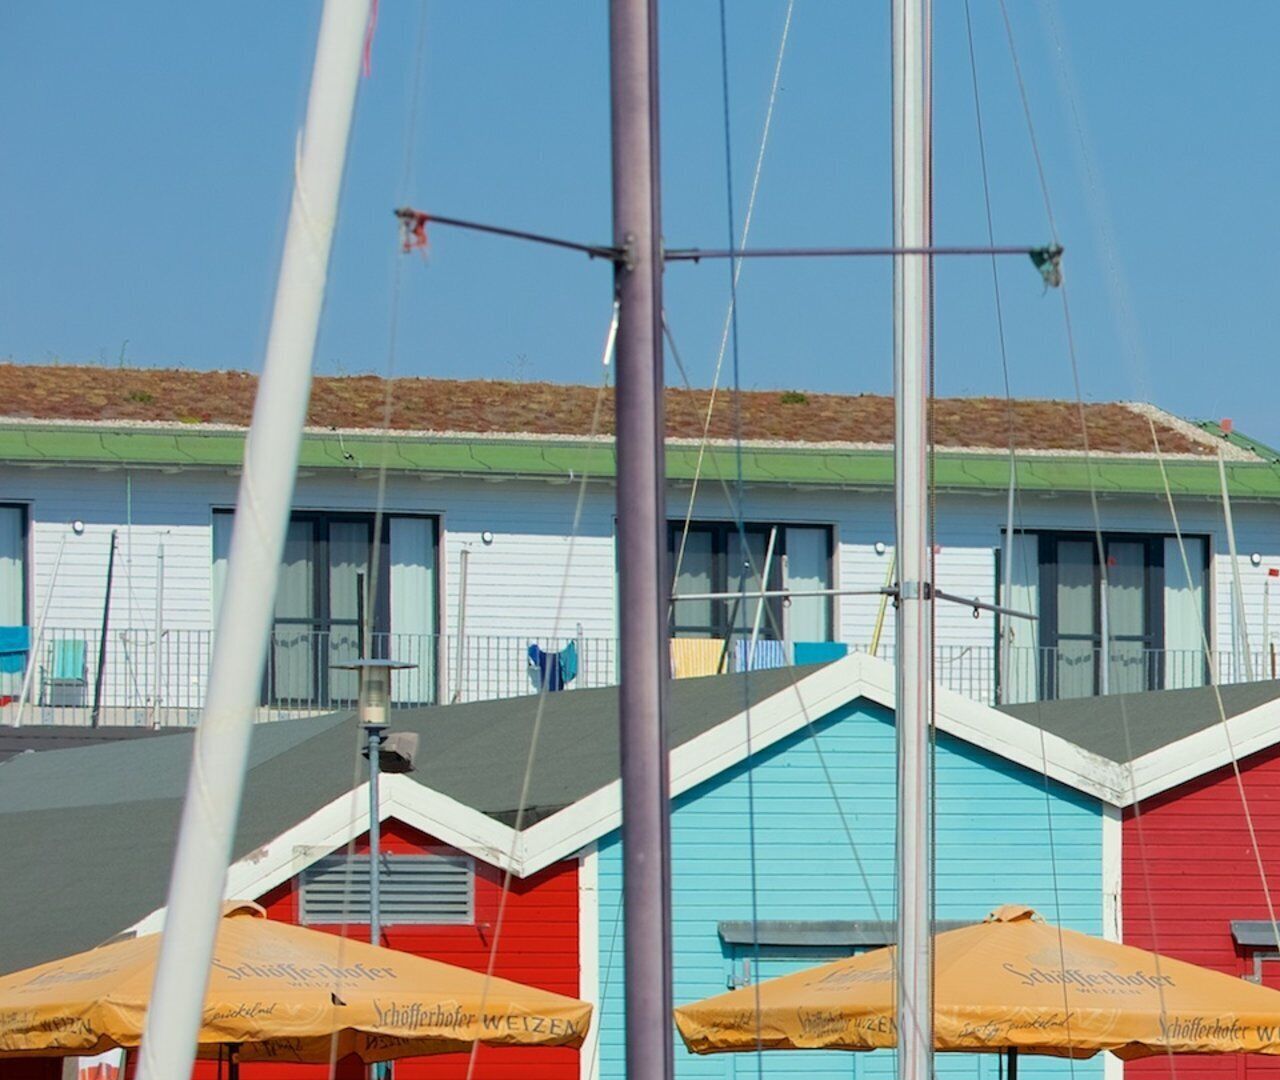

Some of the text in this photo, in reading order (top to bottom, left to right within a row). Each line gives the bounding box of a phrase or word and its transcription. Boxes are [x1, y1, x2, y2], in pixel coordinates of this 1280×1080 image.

[1002, 963, 1177, 988] Schöfferhofer
[372, 998, 581, 1037] Schöfferhofer WEIZEN
[1157, 1010, 1250, 1043] Schöfferhofer
